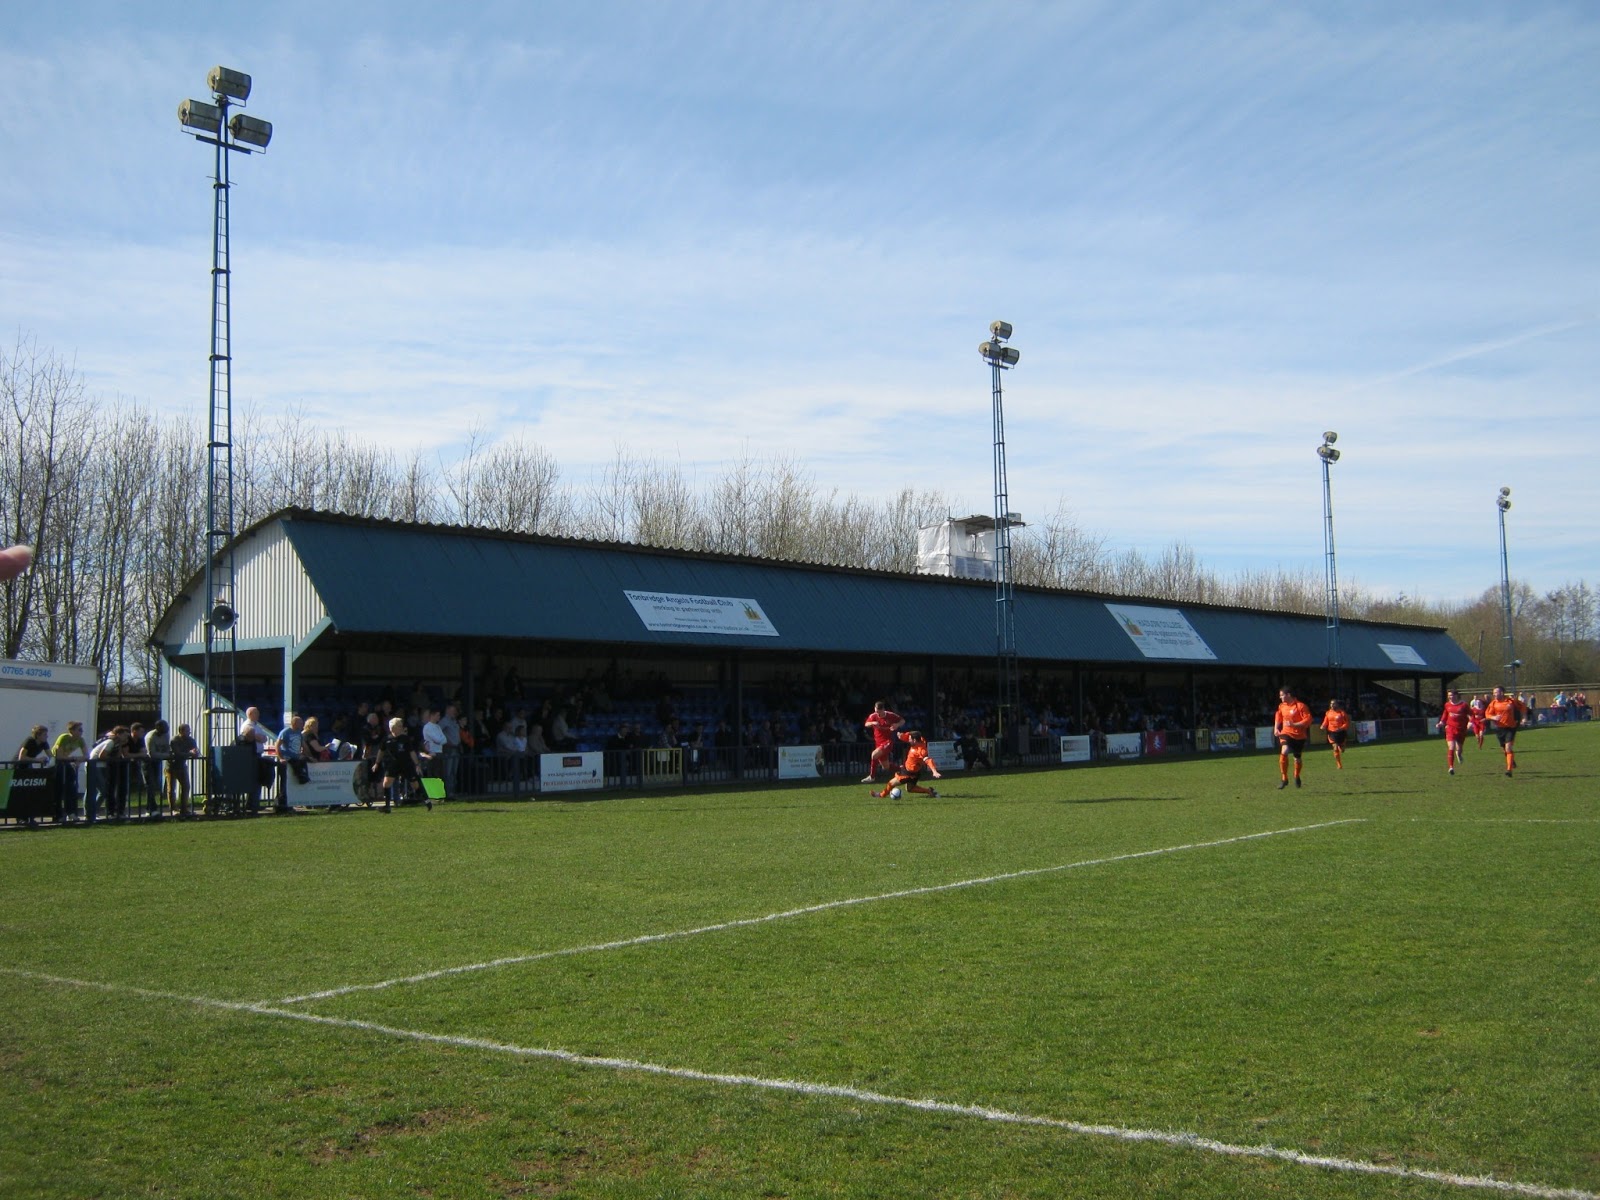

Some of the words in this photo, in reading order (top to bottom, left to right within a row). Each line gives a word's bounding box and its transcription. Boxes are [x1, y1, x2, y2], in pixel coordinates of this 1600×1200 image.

[627, 593, 665, 604] Tonbridge
[666, 595, 690, 605] Angels
[689, 597, 718, 606] Football
[717, 599, 734, 607] Club
[2, 666, 24, 675] 07765
[26, 668, 52, 677] 437346
[10, 778, 47, 787] RACISM
